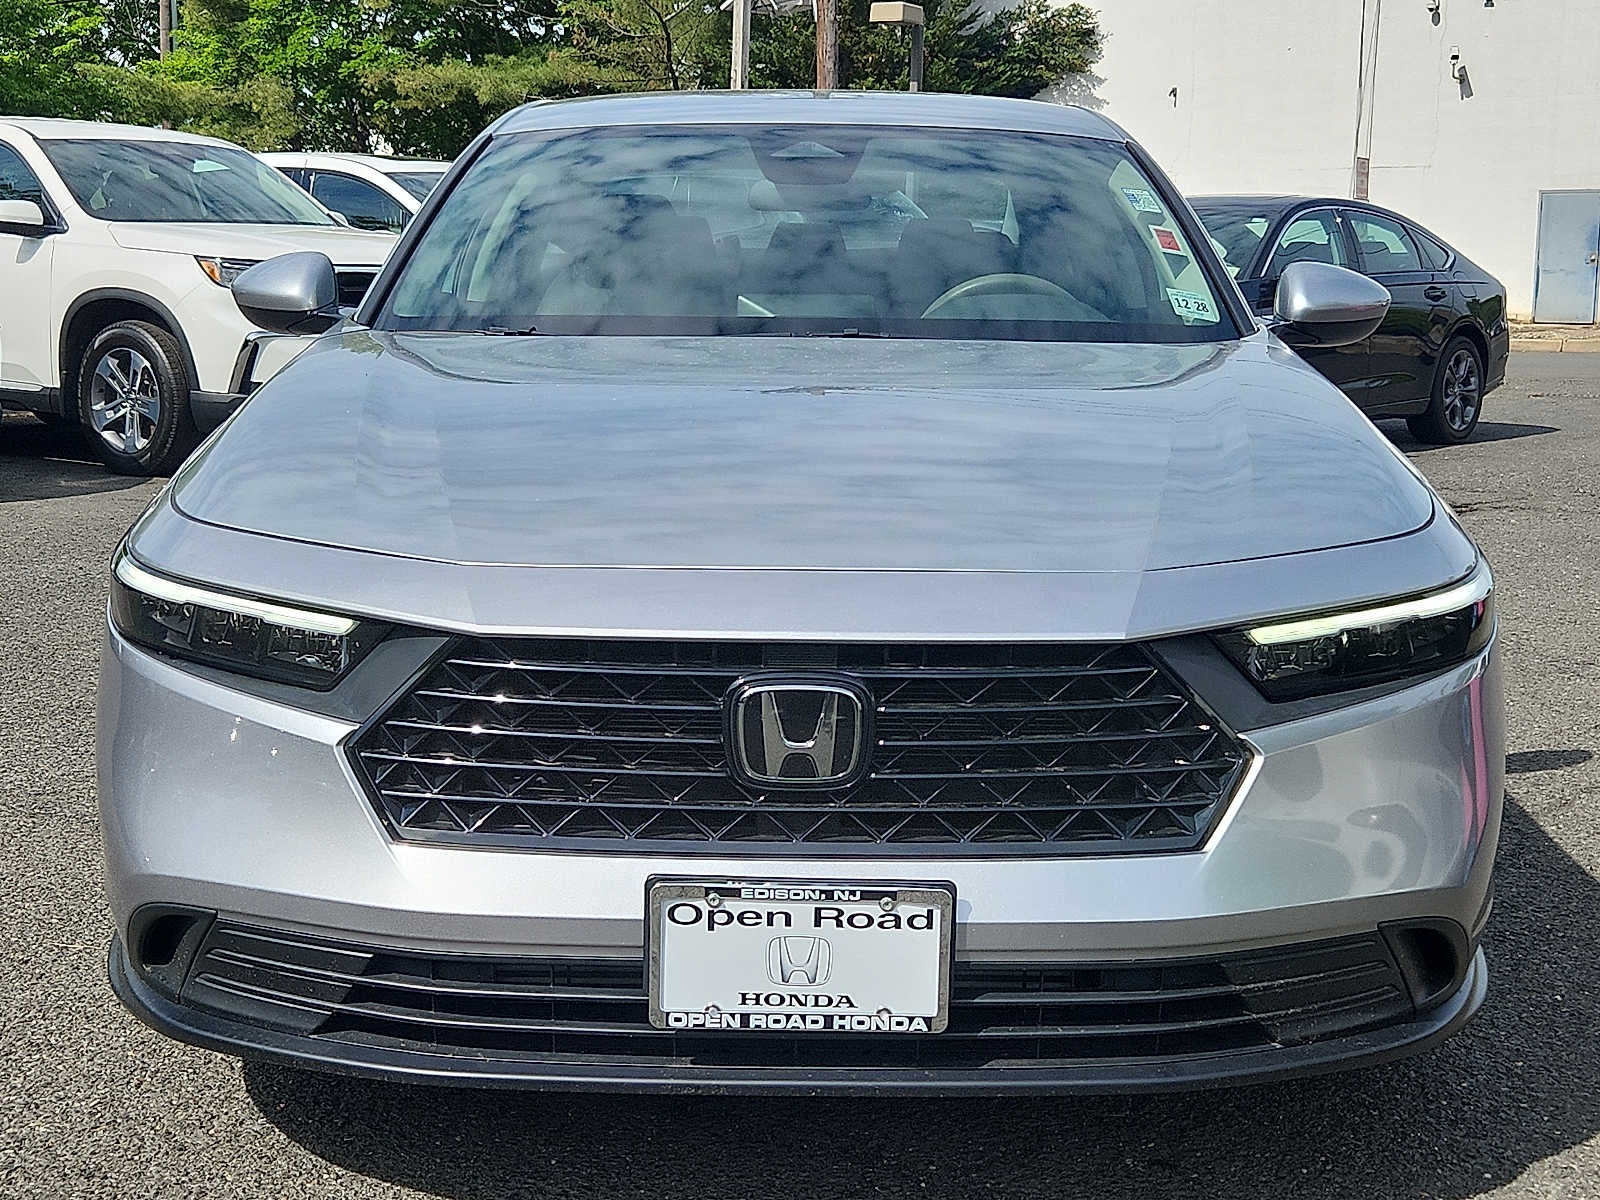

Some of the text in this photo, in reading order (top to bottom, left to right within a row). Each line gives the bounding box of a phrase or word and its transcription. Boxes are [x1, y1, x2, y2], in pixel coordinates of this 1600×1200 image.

[1174, 297, 1191, 309] 12
[1193, 301, 1209, 312] 28
[834, 889, 861, 902] NJ
[667, 902, 934, 932] Open Road
[738, 992, 858, 1009] HONDA
[668, 1012, 929, 1033] OPEN ROAD HONDA
